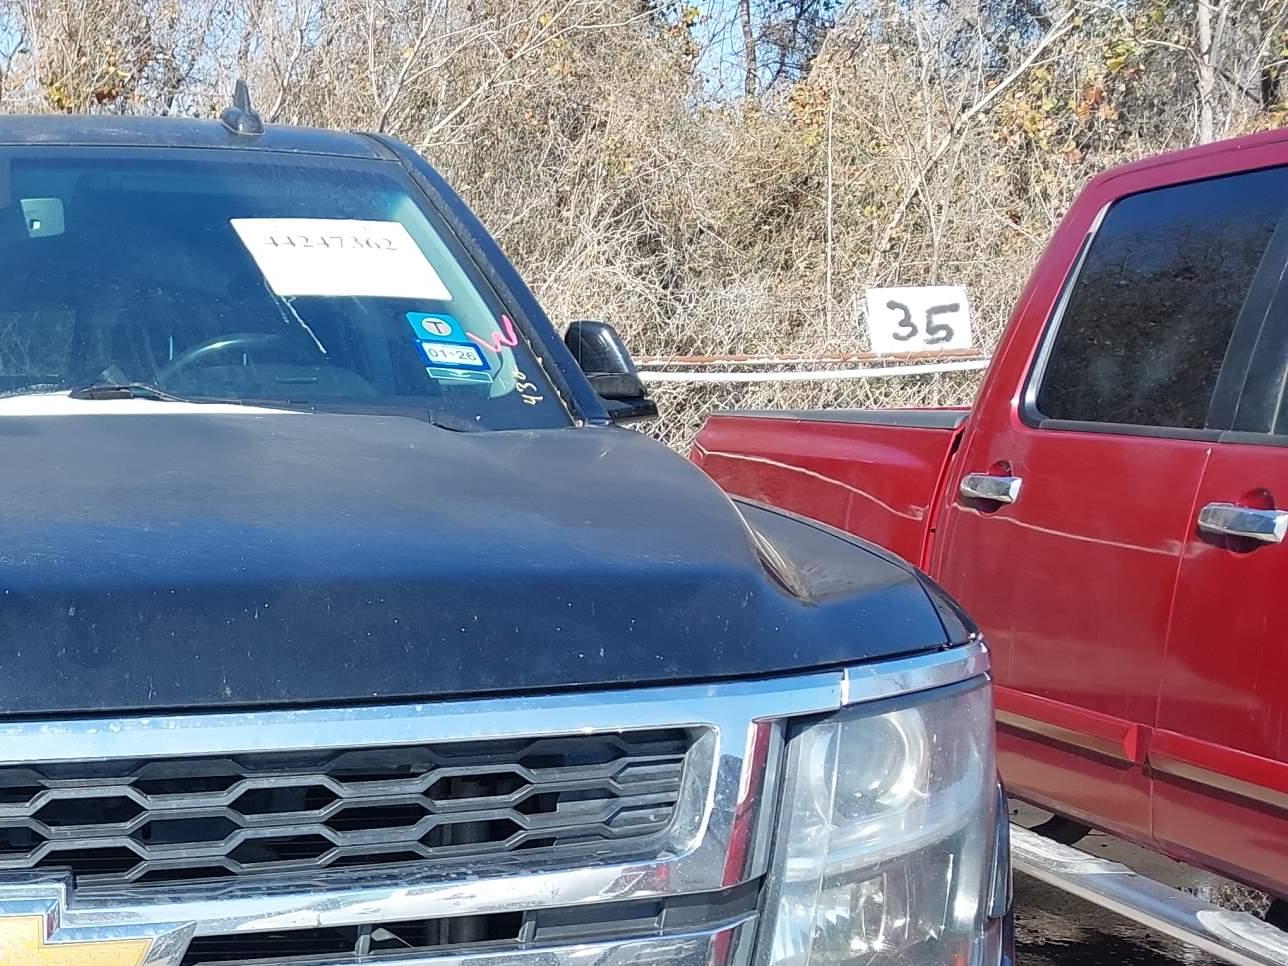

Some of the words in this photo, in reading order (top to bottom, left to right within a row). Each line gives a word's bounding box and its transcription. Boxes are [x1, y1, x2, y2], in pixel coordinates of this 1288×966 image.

[425, 320, 445, 334] T
[886, 300, 961, 345] 35
[427, 347, 477, 362] 01-26
